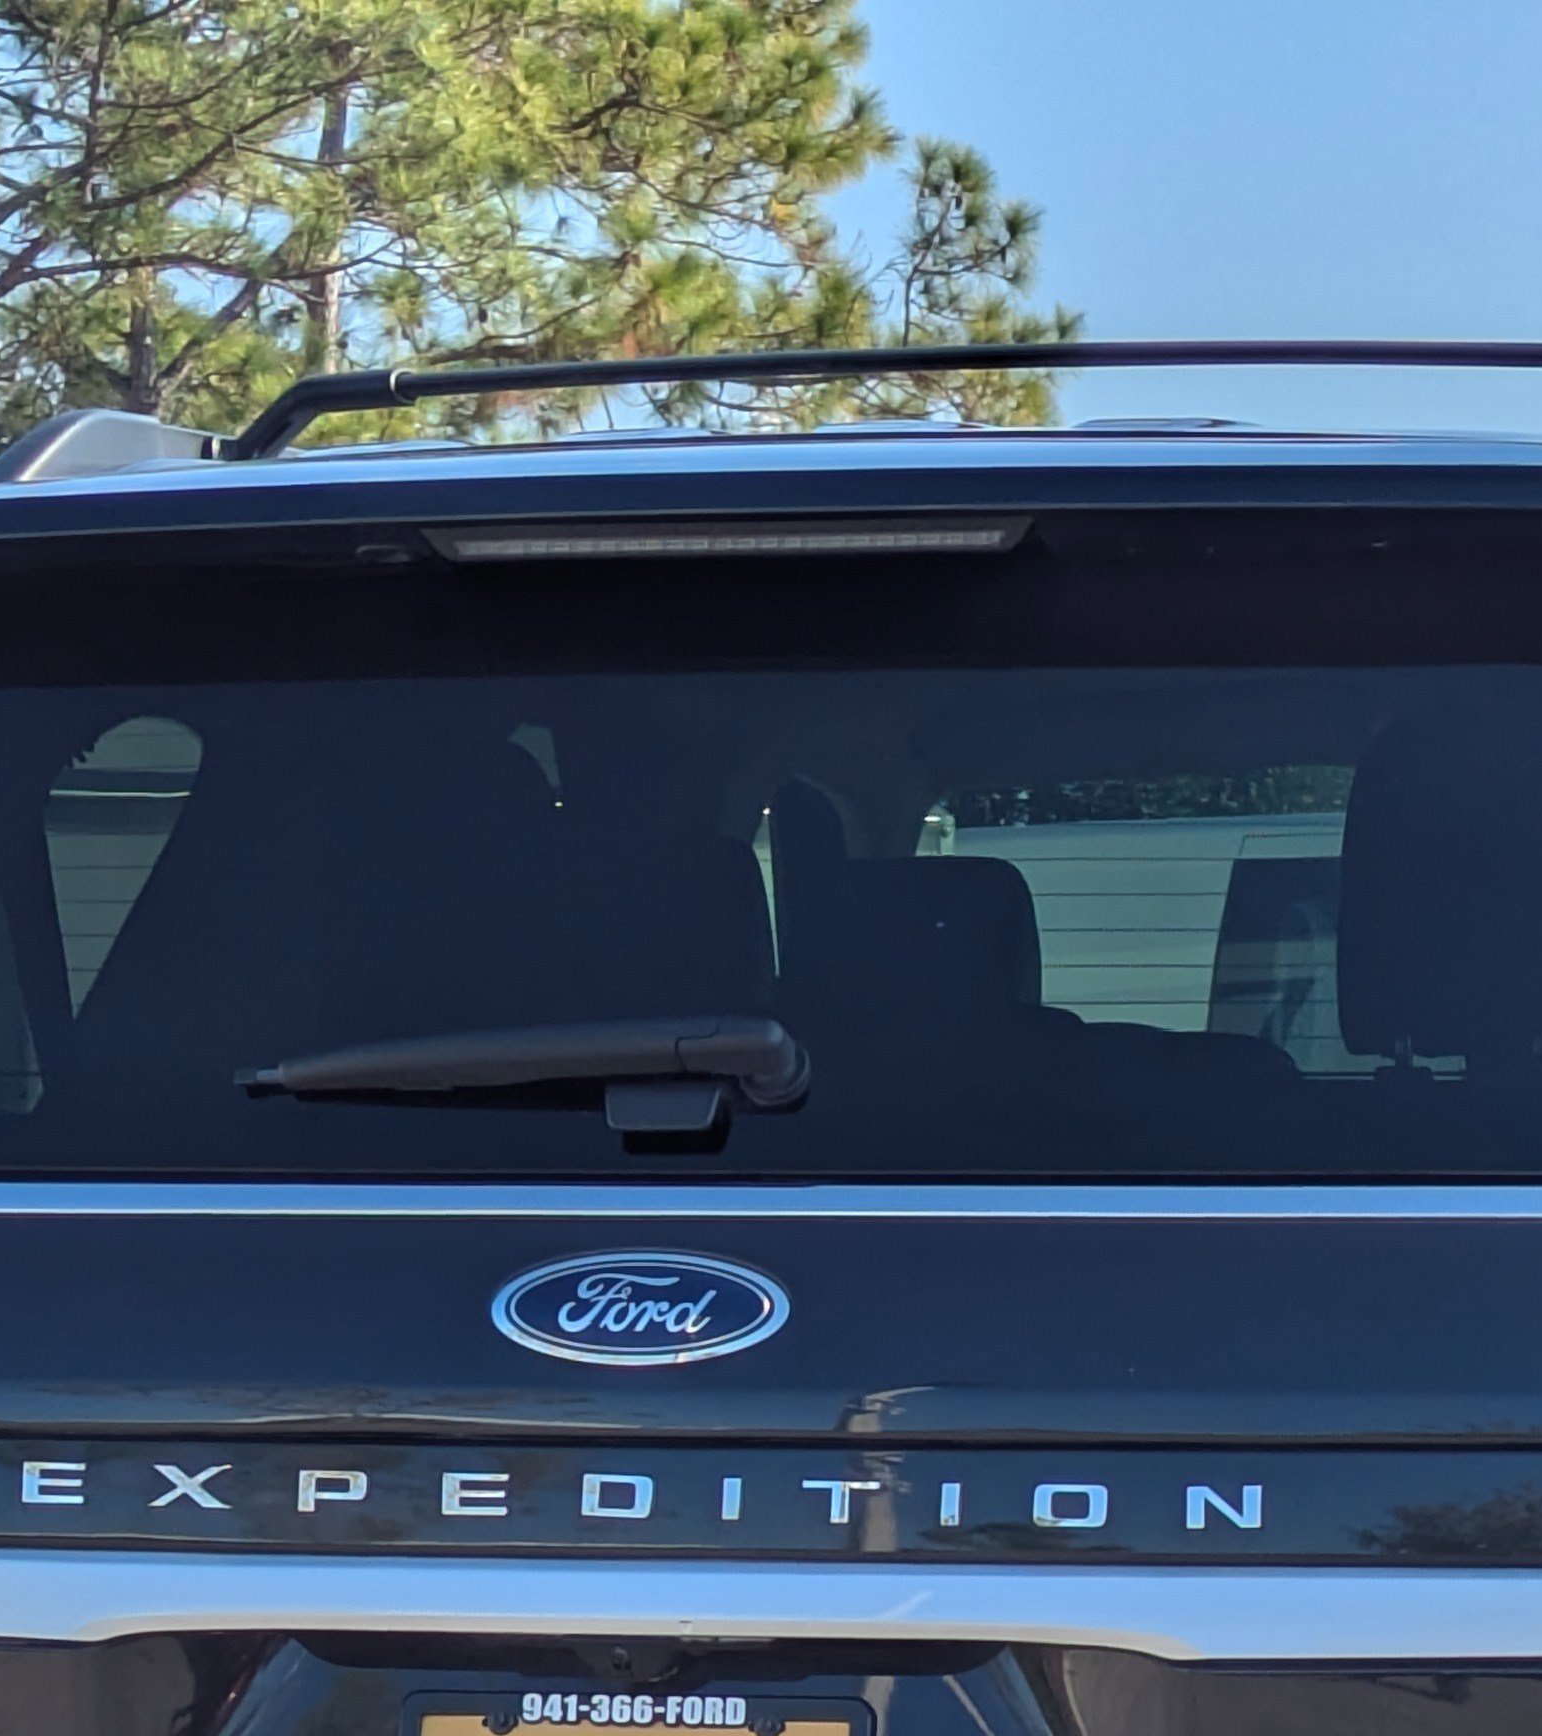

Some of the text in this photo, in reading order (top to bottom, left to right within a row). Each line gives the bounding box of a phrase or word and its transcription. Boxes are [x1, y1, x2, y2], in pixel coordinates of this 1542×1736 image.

[557, 1273, 717, 1334] Ford
[19, 1460, 1265, 1532] EXPEDITION
[521, 1693, 747, 1727] 941-366-FORD
